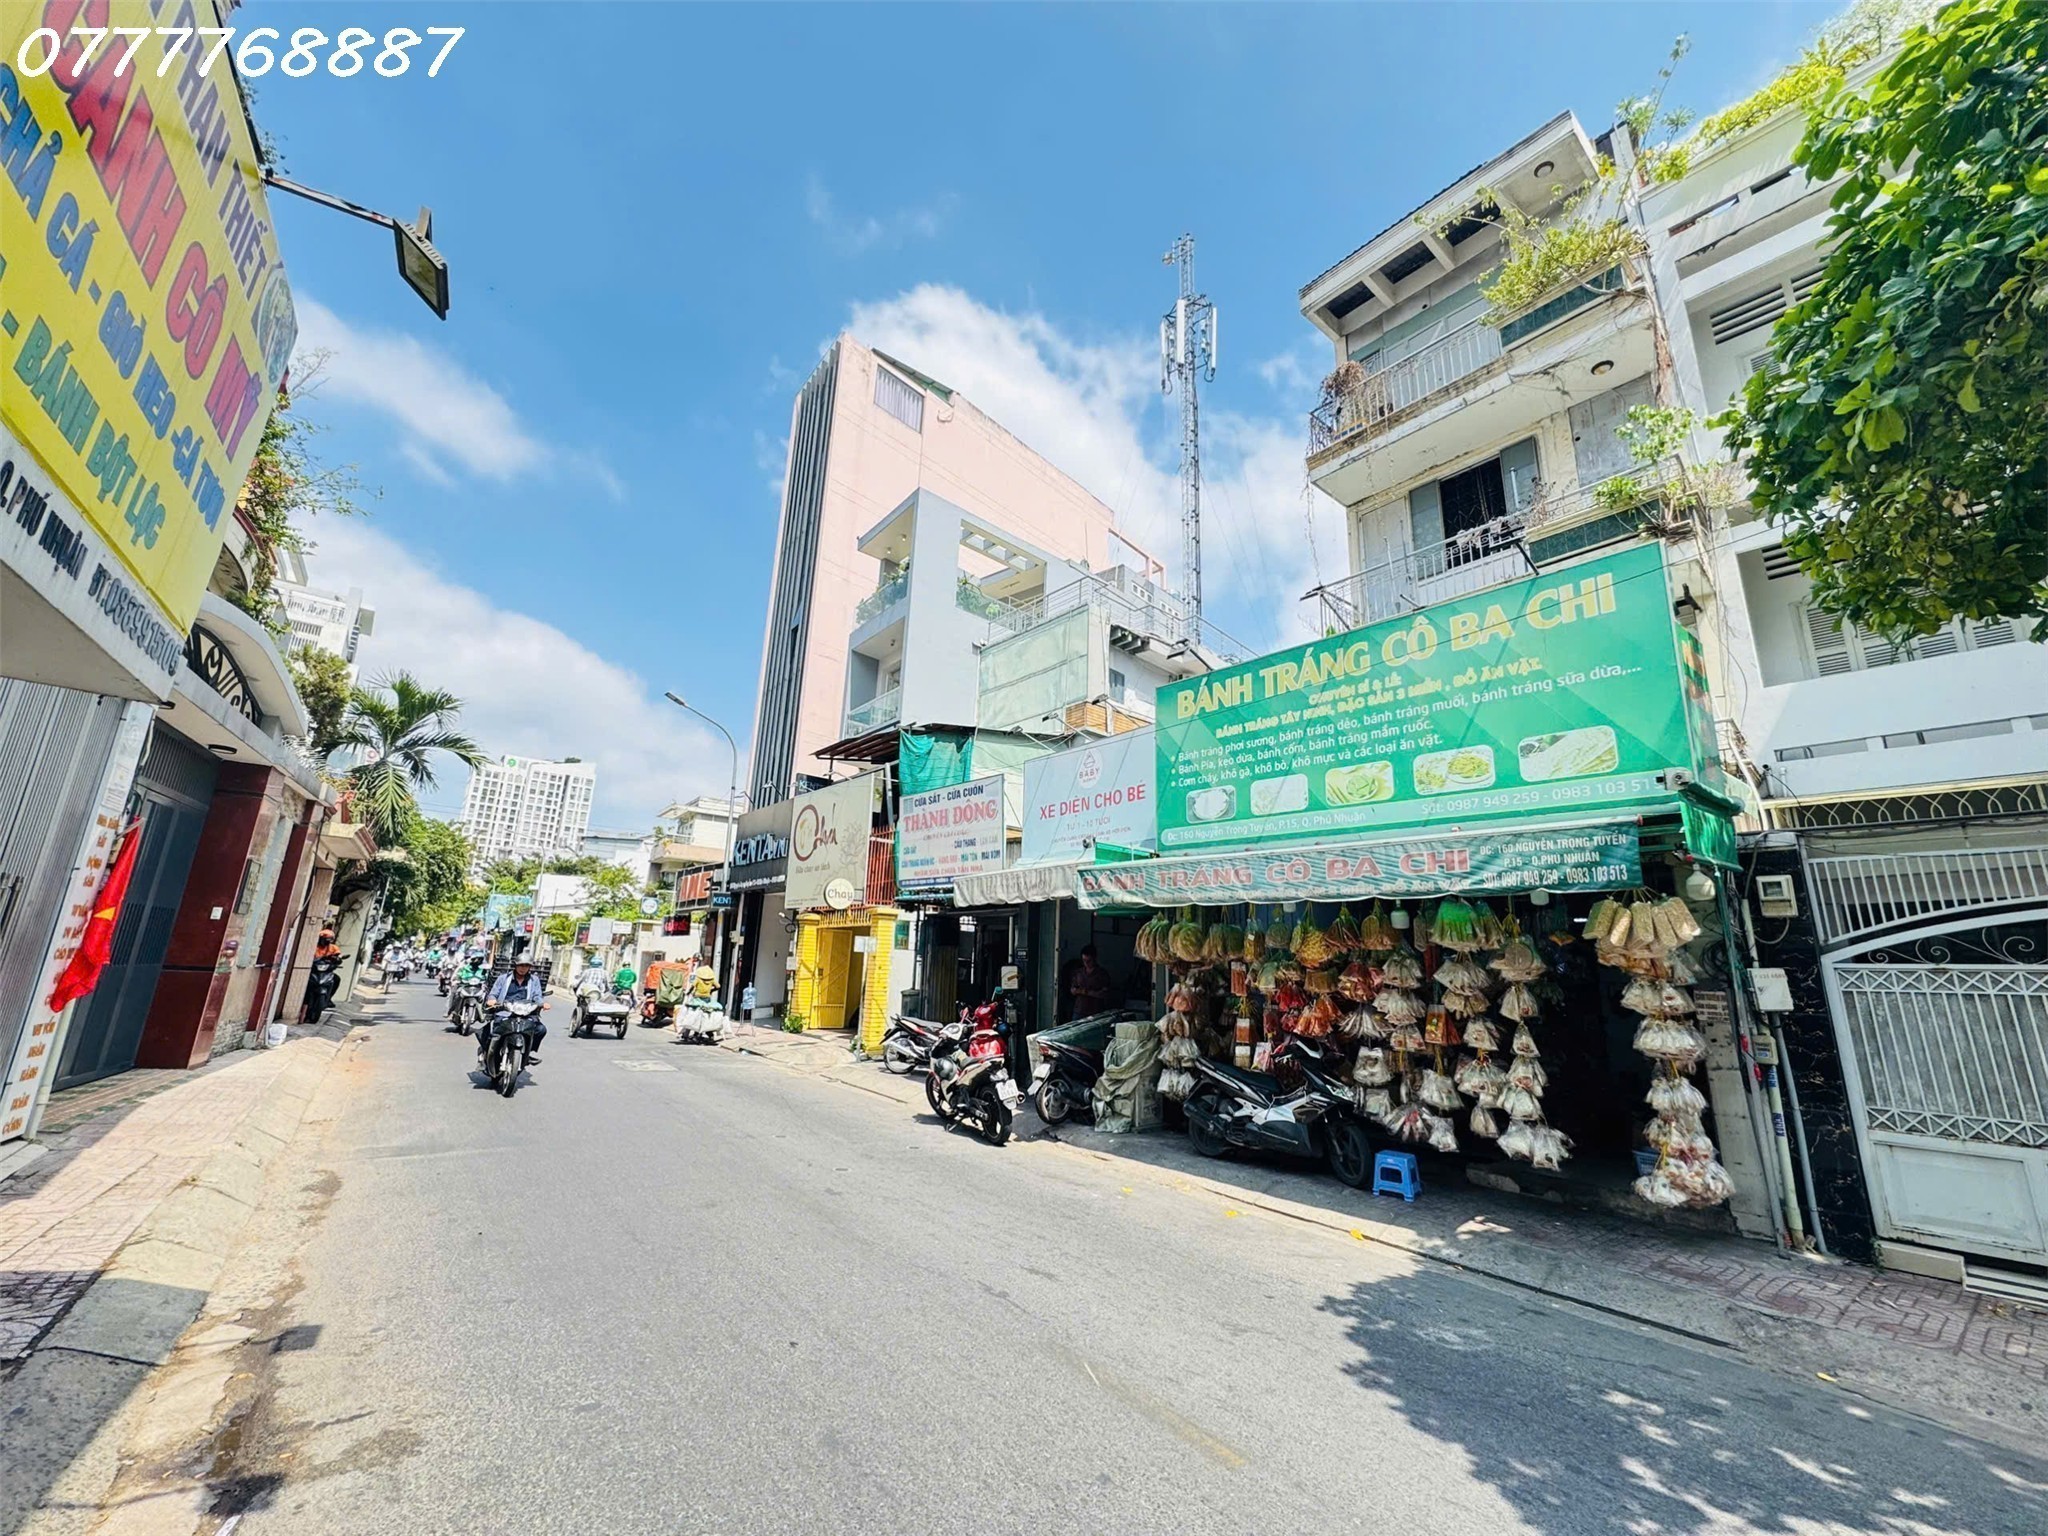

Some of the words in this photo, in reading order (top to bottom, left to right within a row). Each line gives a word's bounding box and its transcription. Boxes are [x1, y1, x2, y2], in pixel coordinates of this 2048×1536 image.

[46, 192, 100, 295] CÁ
[132, 350, 177, 440] HEO
[166, 240, 229, 381] CÔ
[204, 332, 263, 464] MỸ
[13, 314, 101, 457] BÁNH
[86, 417, 139, 508] BỘT
[1177, 673, 1253, 719] BÁNH
[1259, 642, 1372, 699] TRÁNG
[1381, 615, 1438, 667] CÔ
[1450, 604, 1515, 652] BA
[1526, 572, 1617, 629] CHI
[1179, 751, 1199, 762] Bánh
[1201, 747, 1223, 758] tráng
[1279, 727, 1304, 742] bánh
[1306, 722, 1335, 737] tráng
[1363, 711, 1393, 726] bánh
[1396, 704, 1430, 719] tráng
[1472, 687, 1508, 704] bánh
[1511, 676, 1553, 696] tráng
[1557, 671, 1585, 688] sữa
[1079, 768, 1101, 779] BABY
[1179, 763, 1200, 775] Bánh
[1258, 747, 1281, 760] bánh
[1309, 737, 1336, 751] bánh
[1338, 730, 1368, 744] tráng
[1221, 768, 1237, 779] khô
[1254, 762, 1272, 775] khô
[1274, 758, 1290, 771] bò,
[1292, 755, 1311, 769] khô
[1313, 753, 1336, 768] mực
[1338, 747, 1351, 760] và
[1354, 746, 1373, 758] các
[1375, 740, 1397, 755] loại
[1400, 737, 1415, 750] ăn
[1040, 804, 1056, 820] XE
[1094, 790, 1123, 809] CHO
[1127, 779, 1146, 802] BÉ
[1447, 797, 1479, 811] 0987
[1483, 793, 1509, 808] 949
[1513, 791, 1540, 804] 259
[1552, 787, 1592, 801] 0983
[1597, 780, 1626, 795] 103
[1313, 813, 1332, 825] Phú
[1334, 811, 1366, 824] Nhuận
[1497, 843, 1514, 854] 160
[1557, 837, 1590, 851] TRỌNG
[1083, 872, 1146, 892] BÁNH
[1157, 864, 1253, 888] TRÁNG
[1266, 856, 1312, 883] CÔ
[1325, 855, 1383, 881] BA
[1399, 848, 1470, 875] CHI
[1501, 871, 1522, 887] 0987
[1524, 870, 1540, 886] 949
[1541, 869, 1559, 885] 259
[1566, 867, 1590, 884] 0983
[1592, 866, 1608, 882] 103
[1609, 864, 1628, 881] 513
